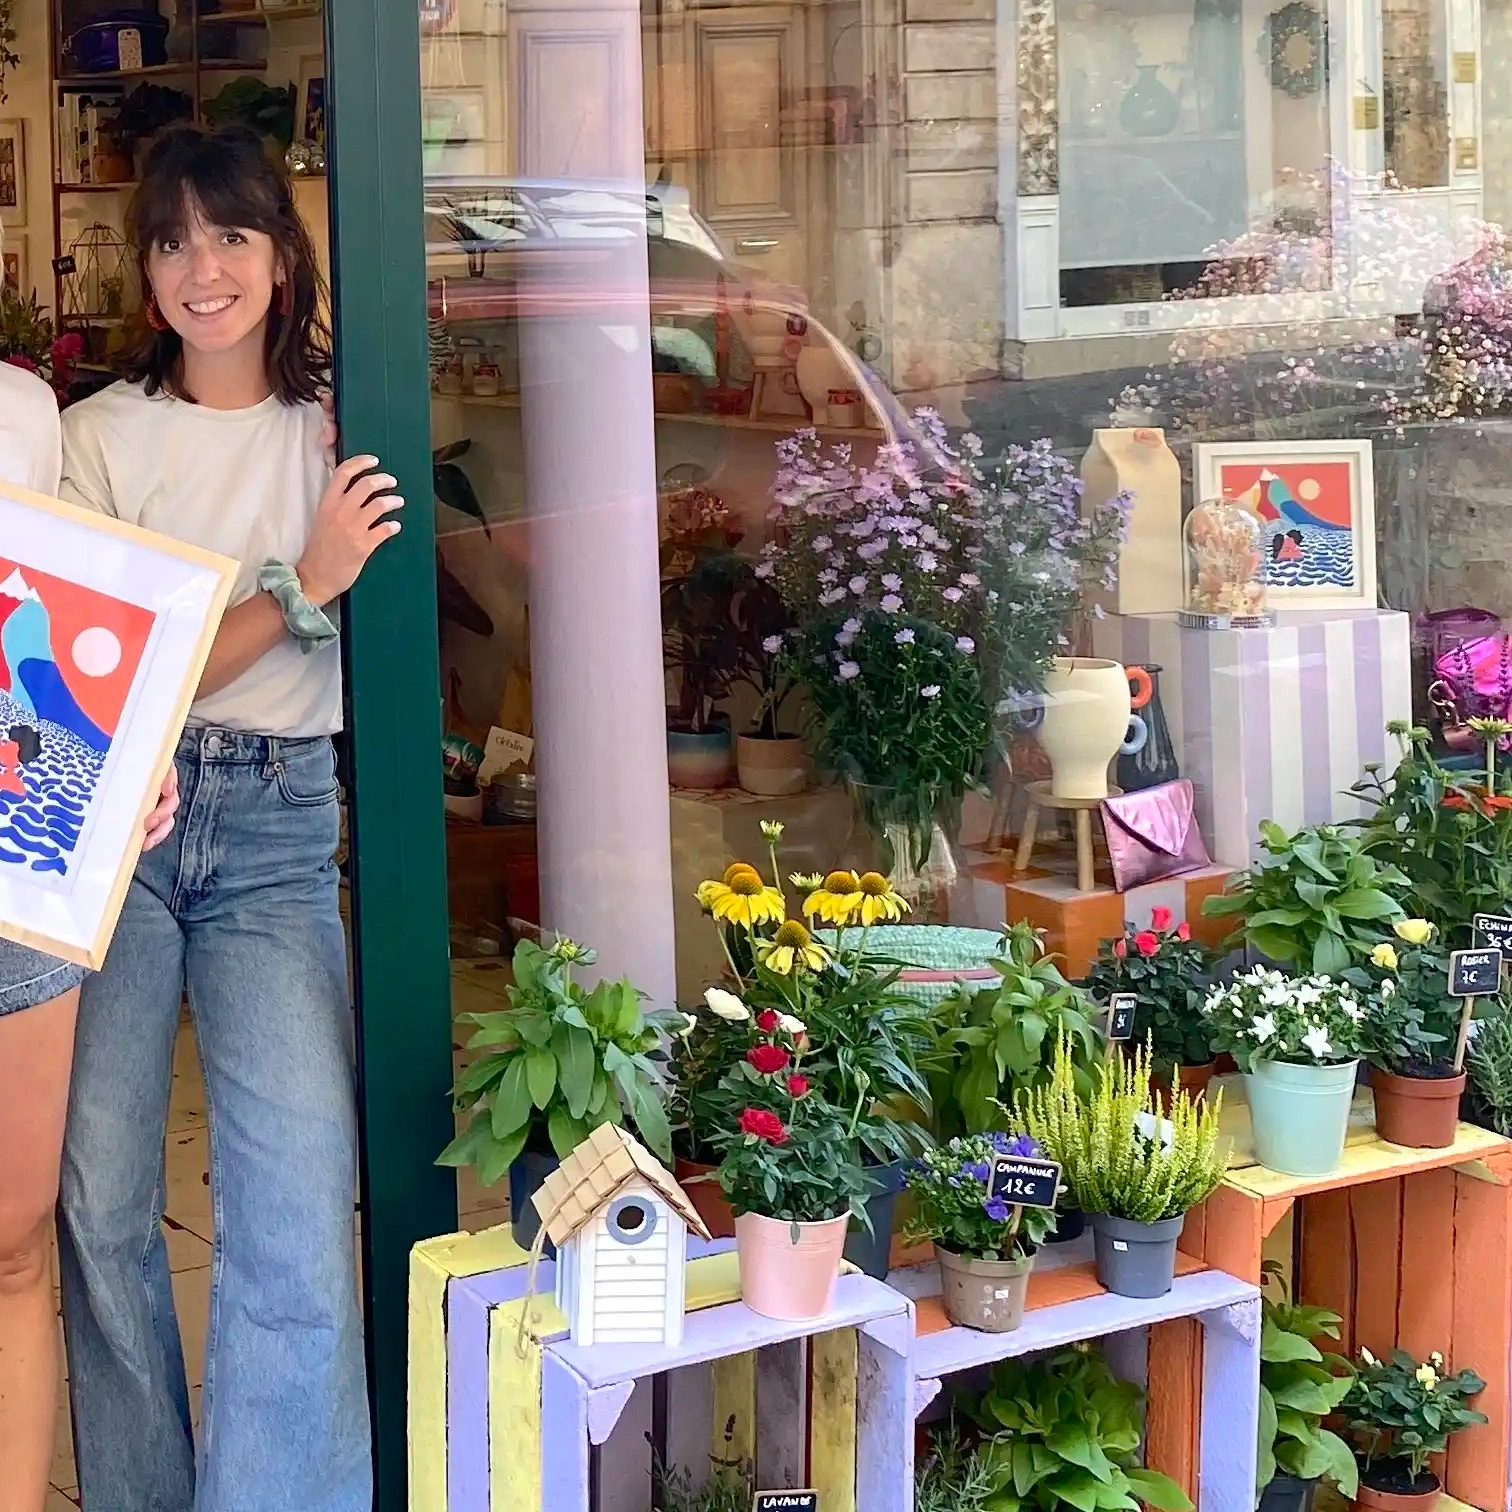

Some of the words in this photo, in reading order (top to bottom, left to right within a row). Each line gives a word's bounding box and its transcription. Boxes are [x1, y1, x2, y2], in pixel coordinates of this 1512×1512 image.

[1461, 970, 1478, 985] 7€
[996, 1162, 1055, 1178] CAMPANULE
[1000, 1178, 1036, 1195] 12€
